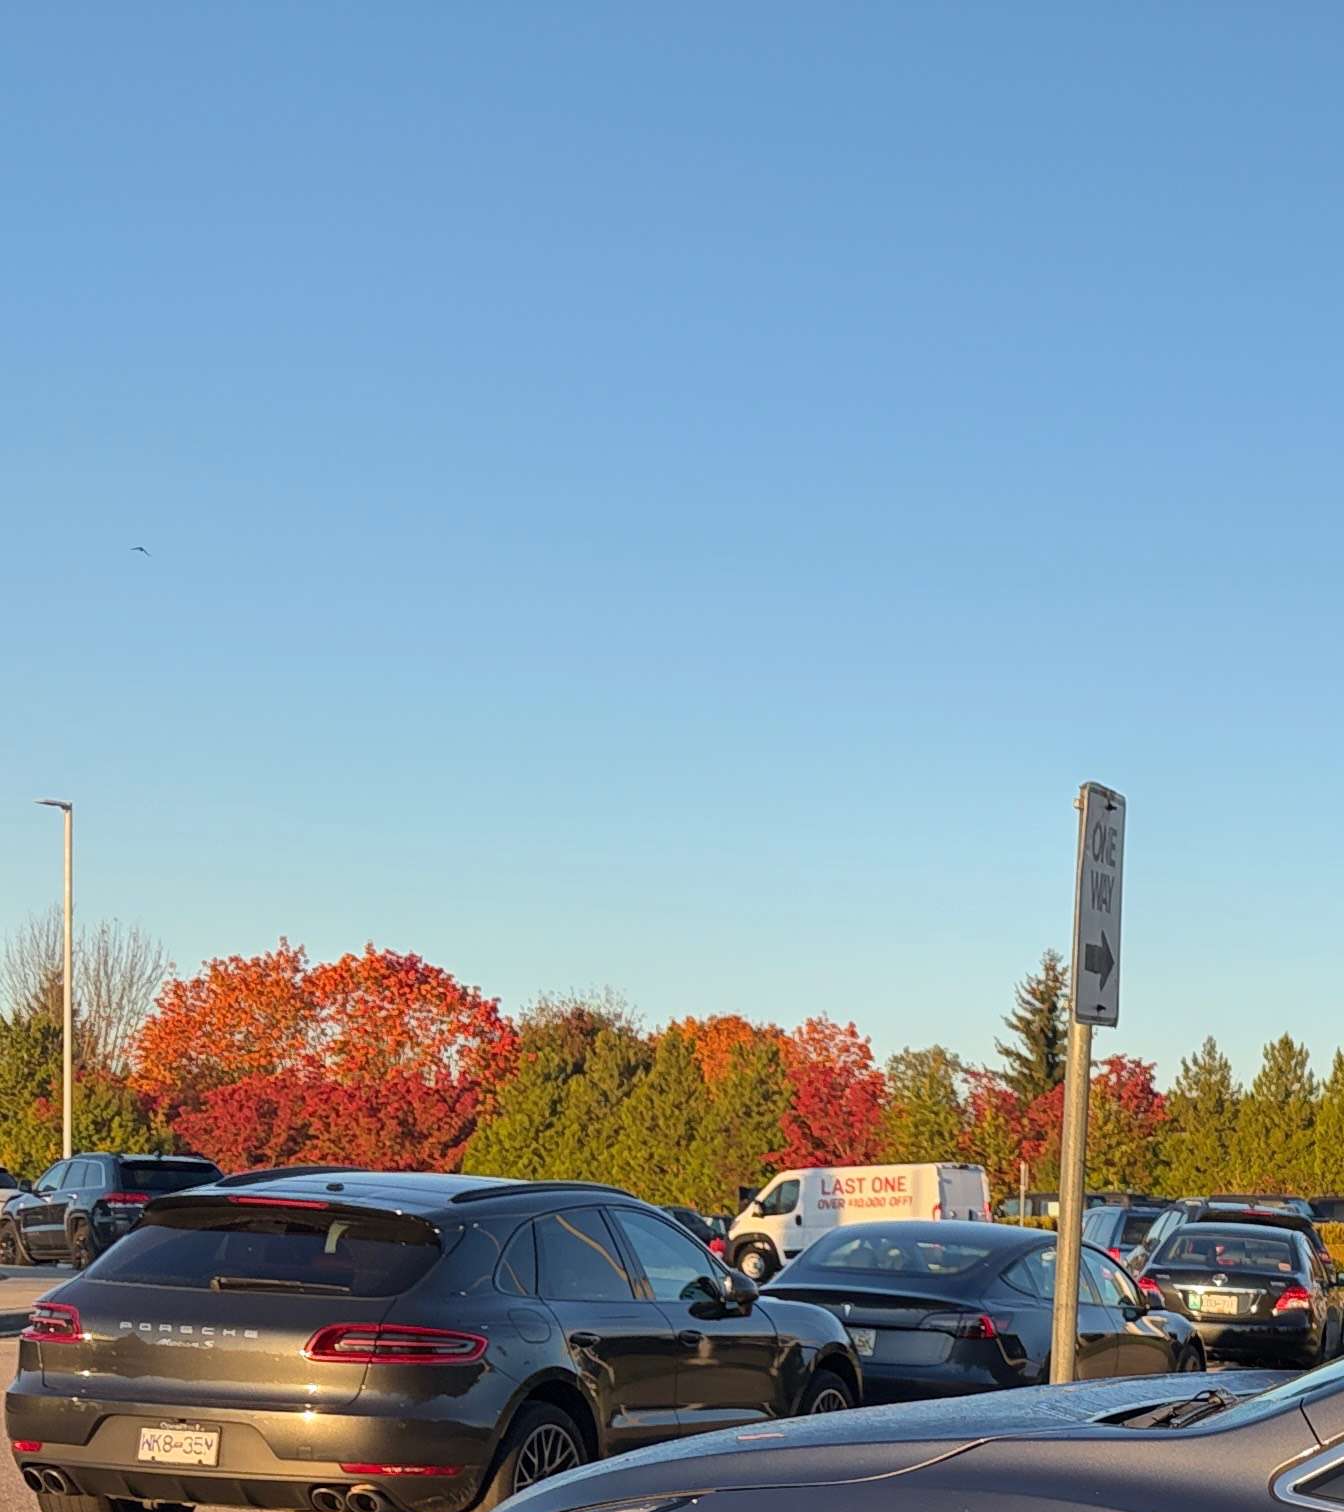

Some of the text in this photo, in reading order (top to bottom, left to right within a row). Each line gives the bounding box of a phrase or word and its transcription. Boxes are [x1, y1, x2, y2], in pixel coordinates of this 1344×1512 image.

[1092, 822, 1117, 868] ONE
[1091, 870, 1115, 914] WAY
[820, 1176, 907, 1196] LAST ONE
[817, 1198, 846, 1210] OVER
[119, 1321, 259, 1339] PORSCHE
